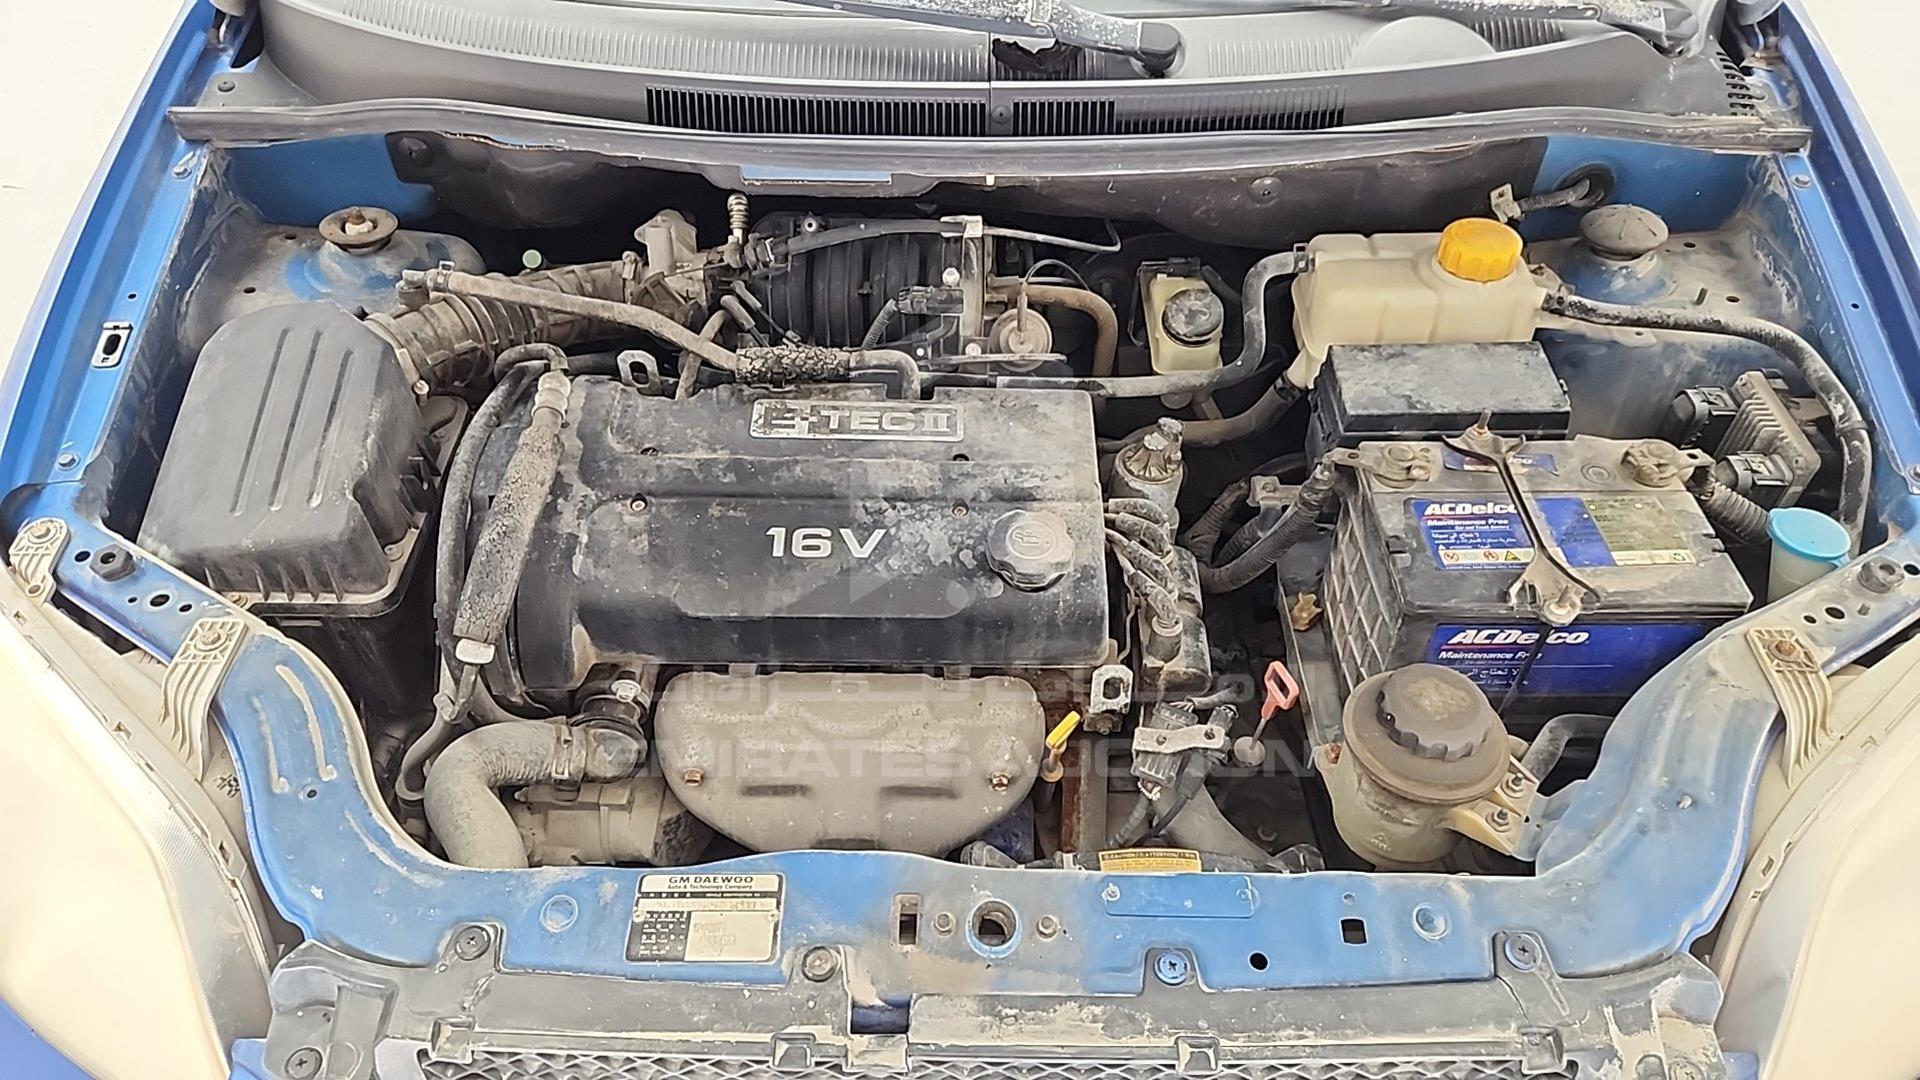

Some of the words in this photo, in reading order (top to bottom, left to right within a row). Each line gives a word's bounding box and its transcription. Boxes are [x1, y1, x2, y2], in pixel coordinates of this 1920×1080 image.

[765, 527, 888, 559] 16V
[1447, 629, 1590, 644] ACDeco
[1438, 651, 1514, 659] Maintenance
[669, 876, 690, 884] GM
[694, 876, 754, 884] DAEWOO
